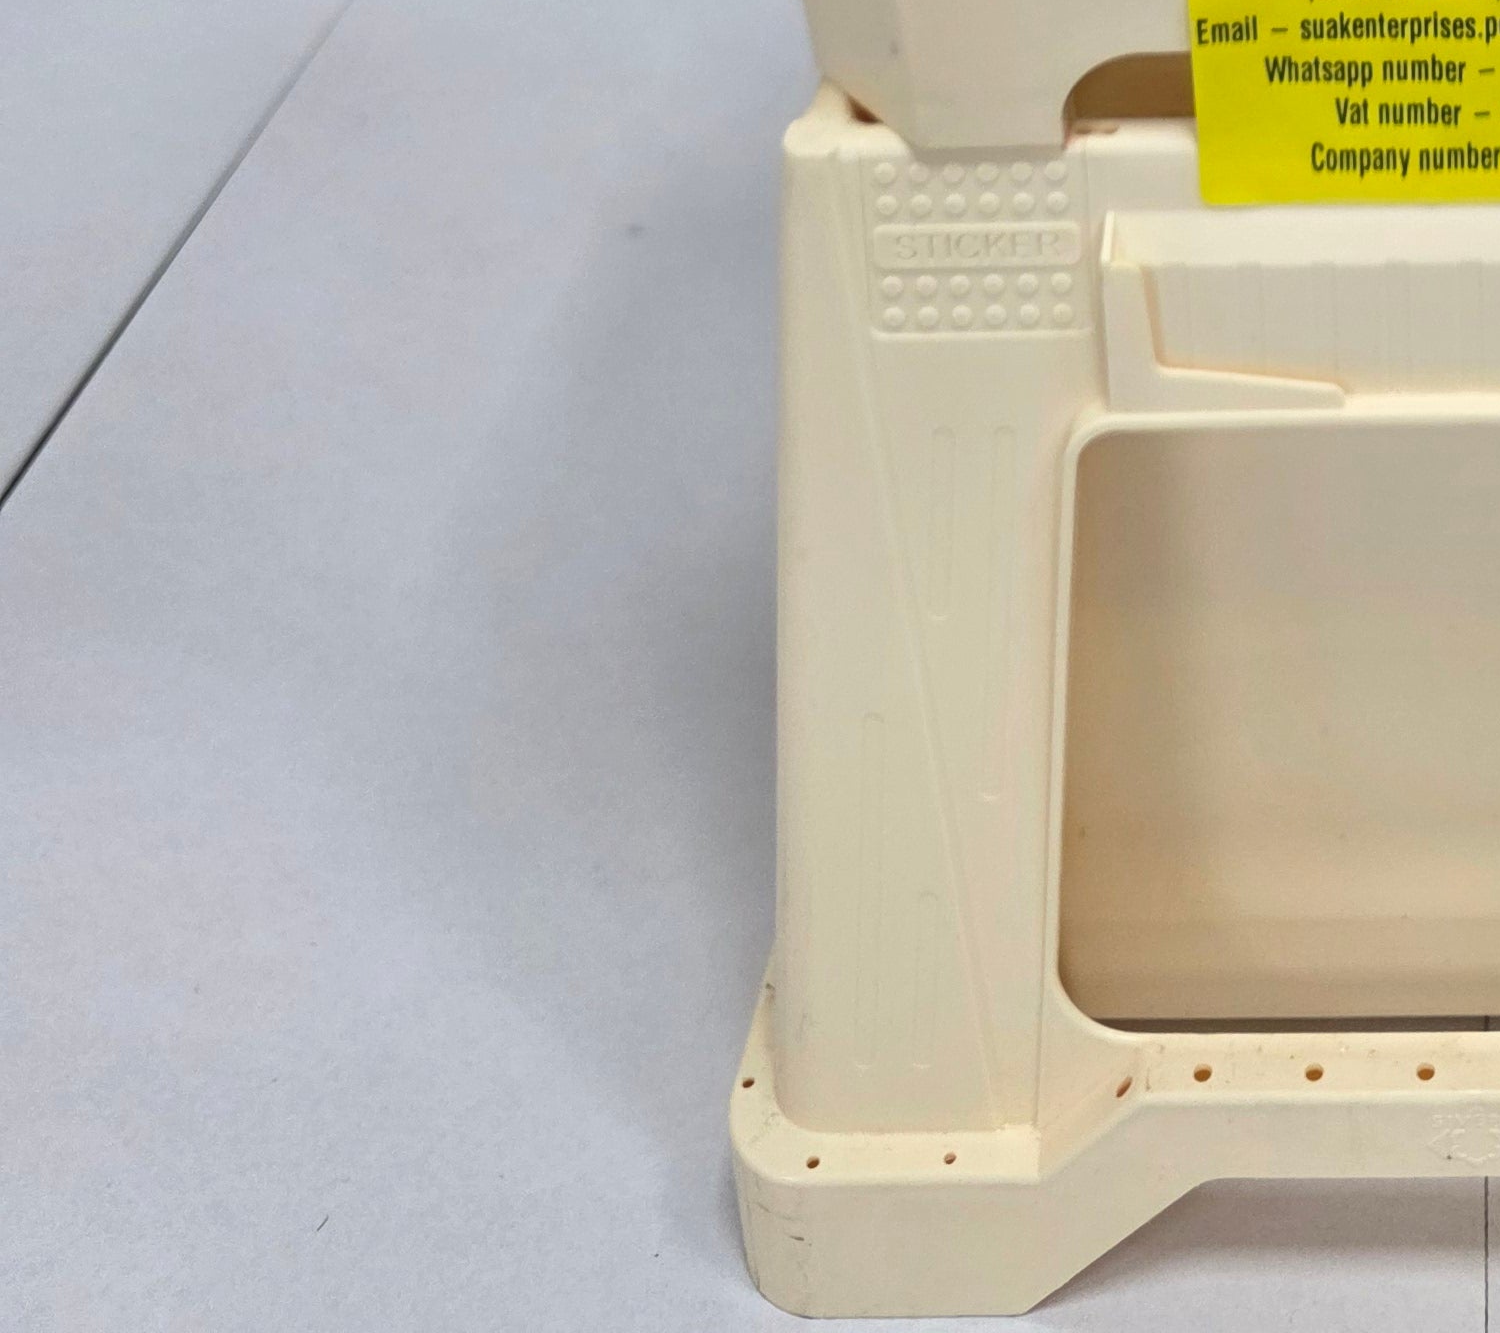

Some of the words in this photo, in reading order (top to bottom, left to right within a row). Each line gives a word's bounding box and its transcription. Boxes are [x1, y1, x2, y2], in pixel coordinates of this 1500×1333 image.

[1196, 15, 1257, 45] Email
[1265, 56, 1373, 89] Whatsapp
[1383, 53, 1466, 83] number
[1335, 97, 1368, 125] Vat
[1379, 97, 1461, 127] number
[1311, 142, 1410, 179] Company
[1419, 141, 1500, 172] number
[895, 232, 1060, 260] STICKER
